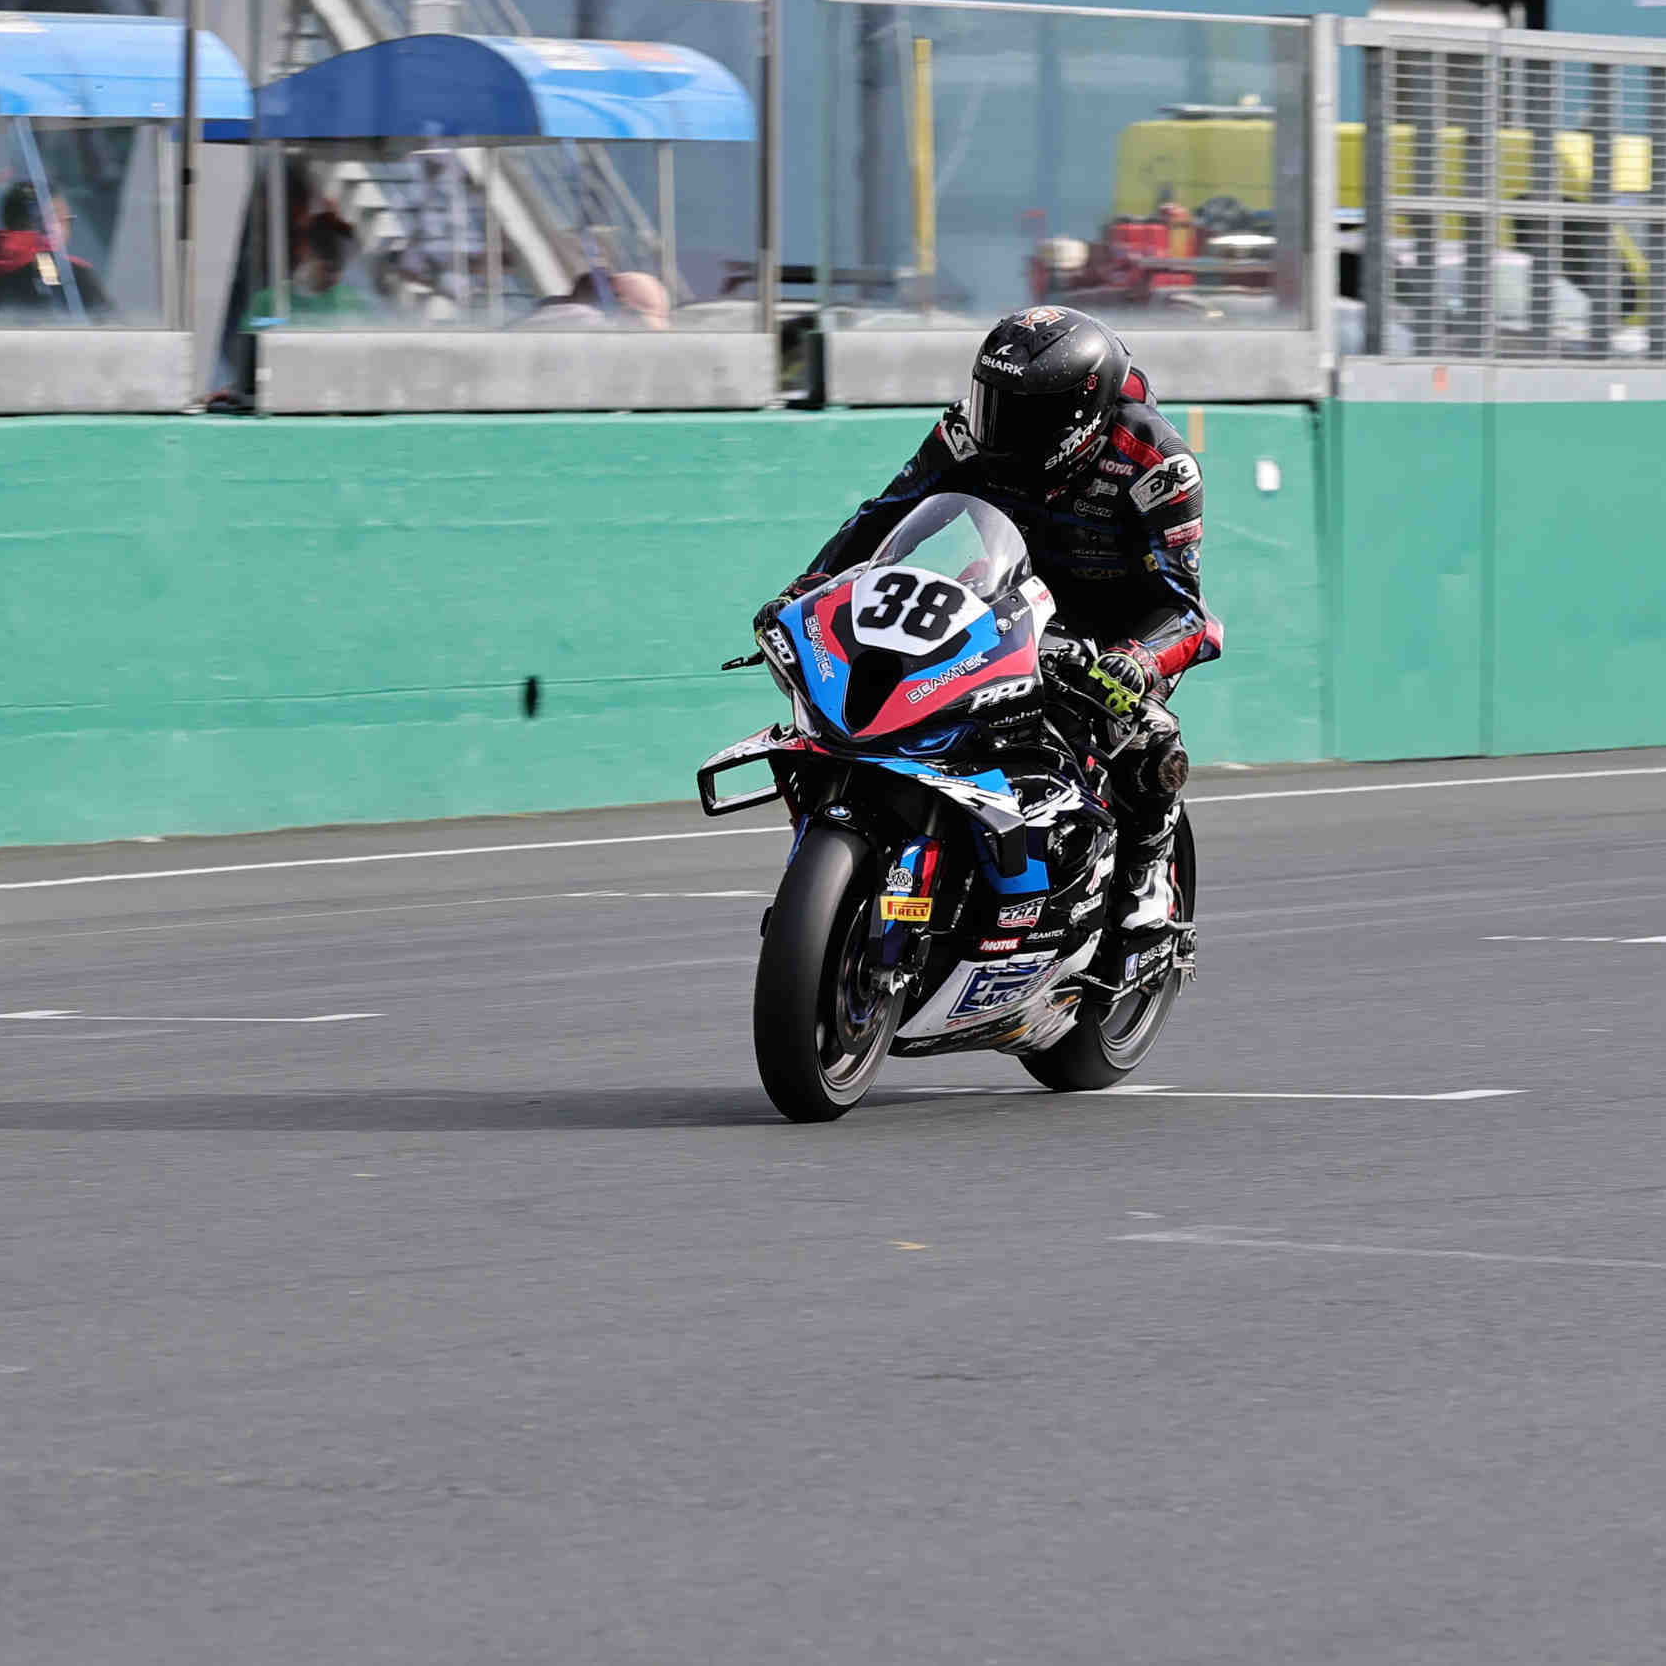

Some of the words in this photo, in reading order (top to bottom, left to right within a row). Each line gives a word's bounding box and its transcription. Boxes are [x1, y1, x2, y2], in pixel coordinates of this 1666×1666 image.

[980, 354, 1026, 377] SHARK
[1044, 410, 1102, 470] SHARK
[856, 572, 966, 642] 38
[766, 626, 796, 664] PPD
[968, 678, 1033, 714] PPD
[980, 939, 1020, 951] MOTUL
